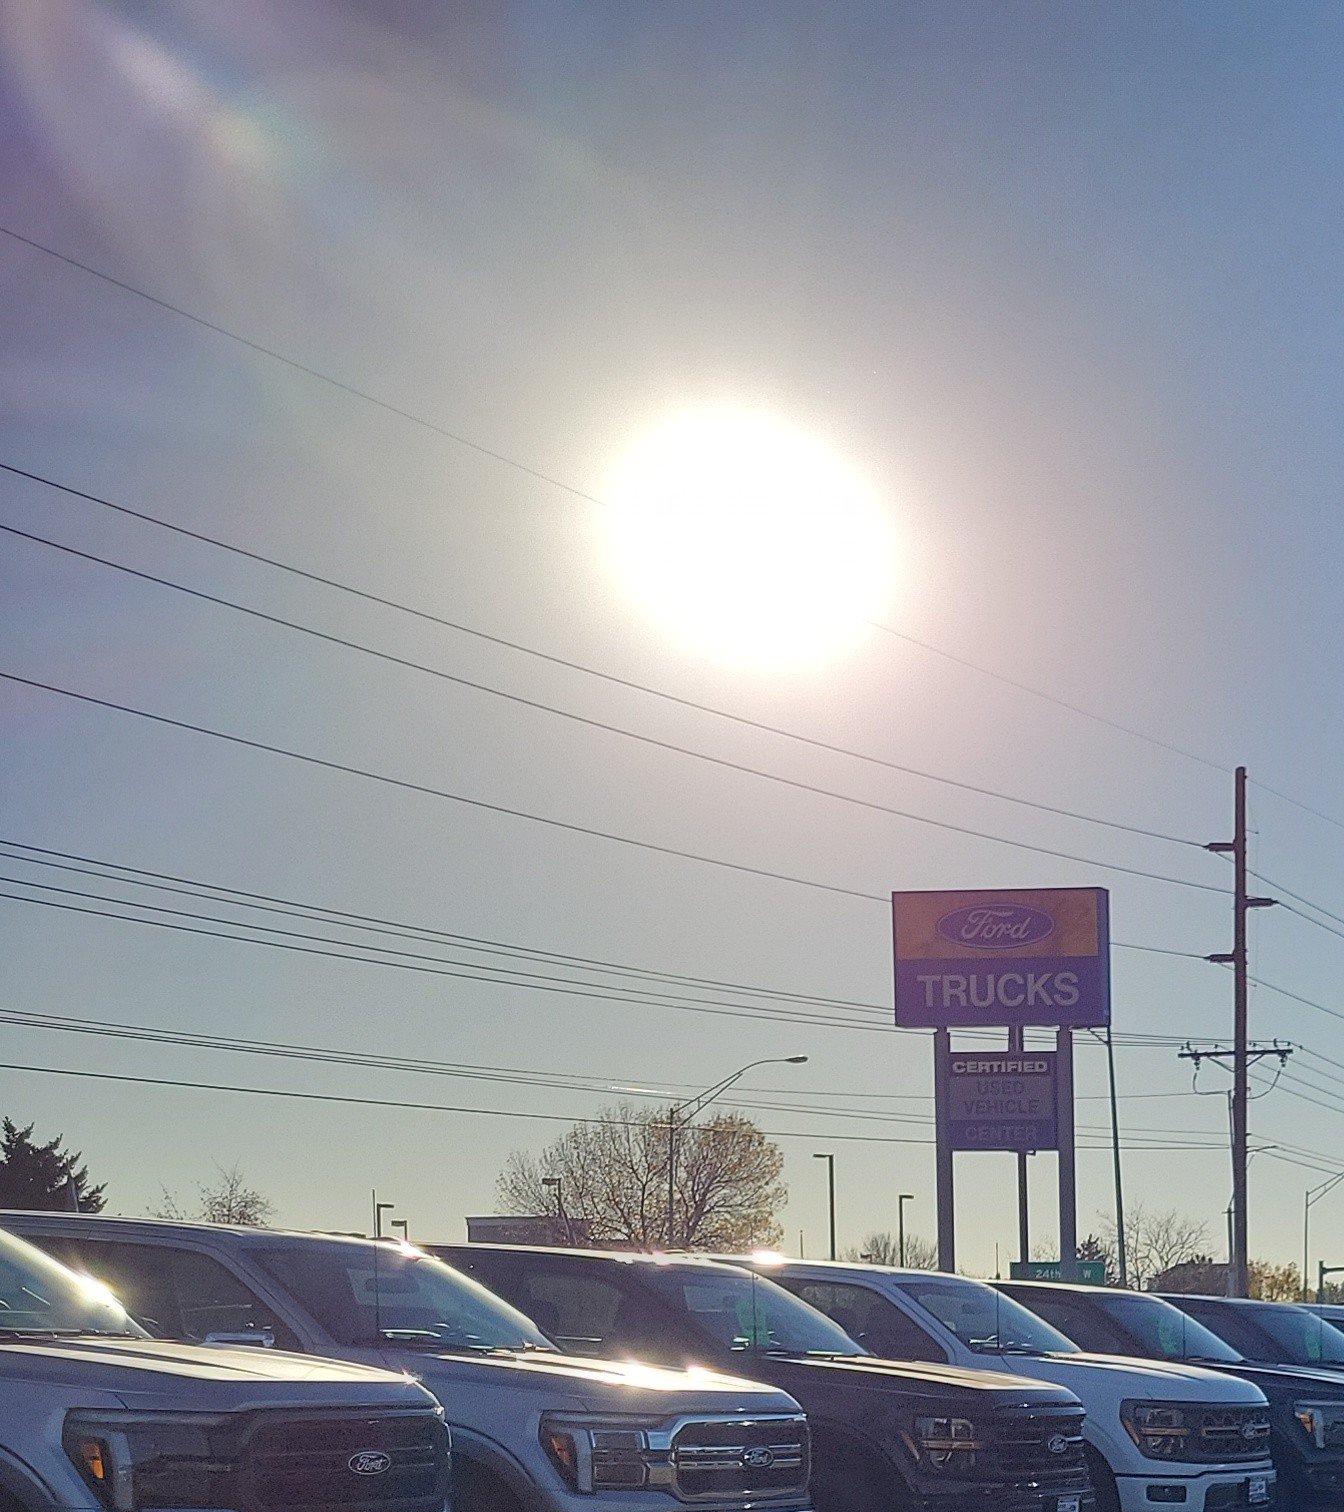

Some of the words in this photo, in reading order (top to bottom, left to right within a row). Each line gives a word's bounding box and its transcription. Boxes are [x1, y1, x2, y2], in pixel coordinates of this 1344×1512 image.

[961, 909, 1031, 940] Ford
[917, 972, 1080, 1007] TRUCKS
[952, 1060, 1048, 1074] CERTIFIED
[977, 1080, 1025, 1096] USED
[965, 1099, 1041, 1115] VEHICLE
[965, 1125, 1037, 1143] CENTER
[1035, 1269, 1062, 1279] 24th
[1083, 1269, 1091, 1278] W
[357, 1454, 384, 1471] Ford
